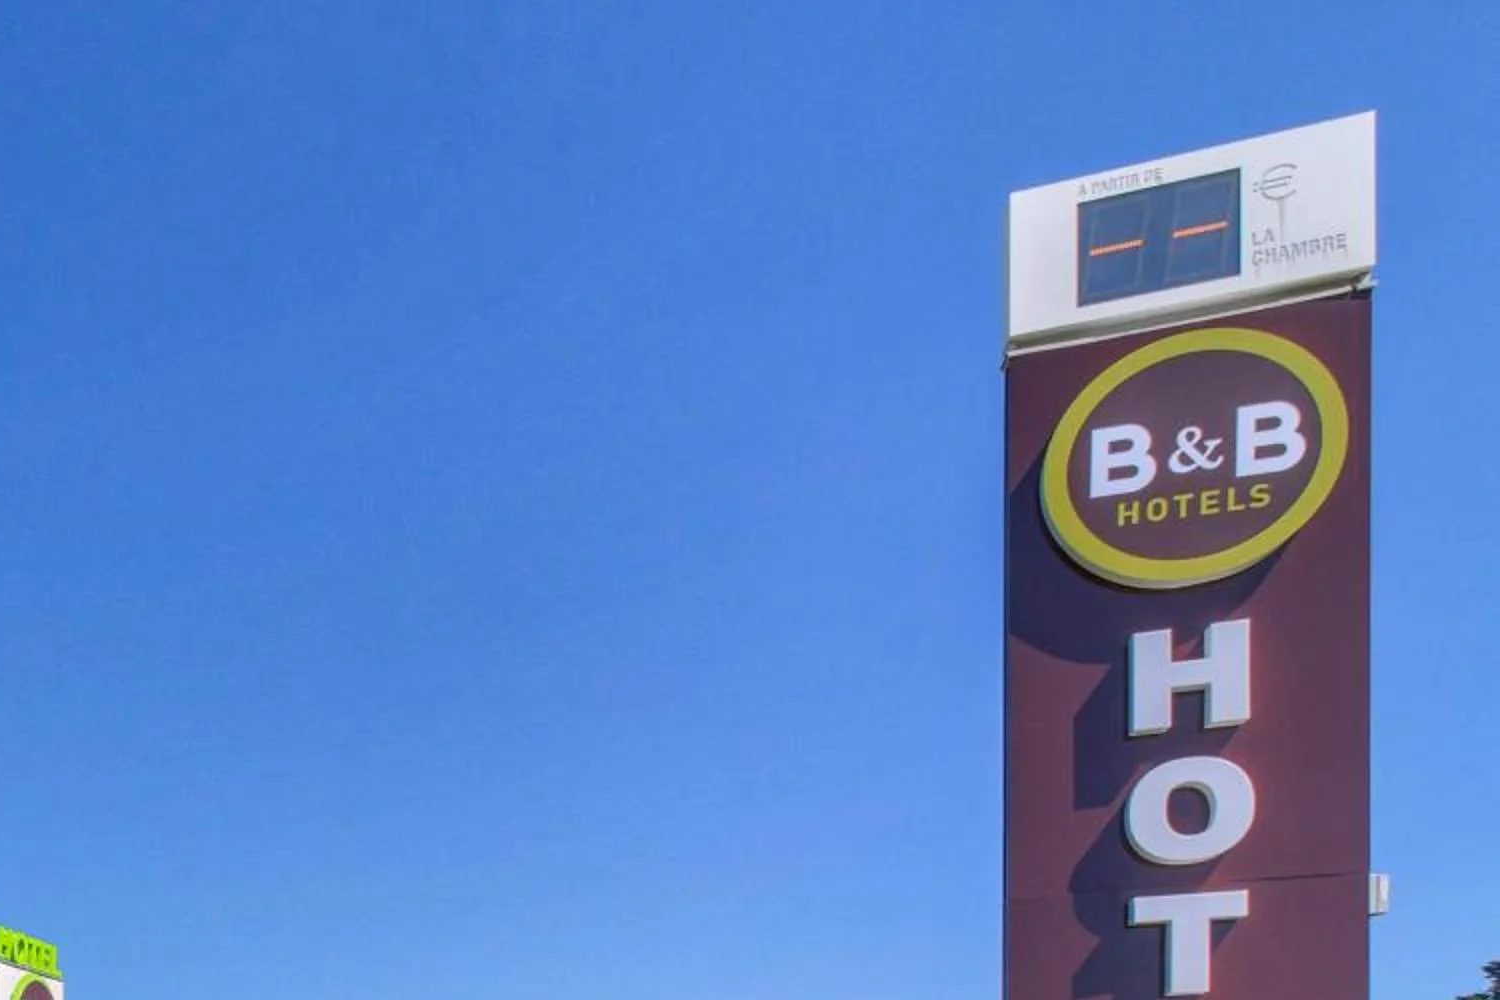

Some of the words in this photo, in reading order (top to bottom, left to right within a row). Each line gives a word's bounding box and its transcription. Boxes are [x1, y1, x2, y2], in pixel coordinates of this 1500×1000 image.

[1251, 229, 1276, 246] LA
[1251, 233, 1347, 267] CHAMBRE
[1116, 483, 1272, 527] HOTELS
